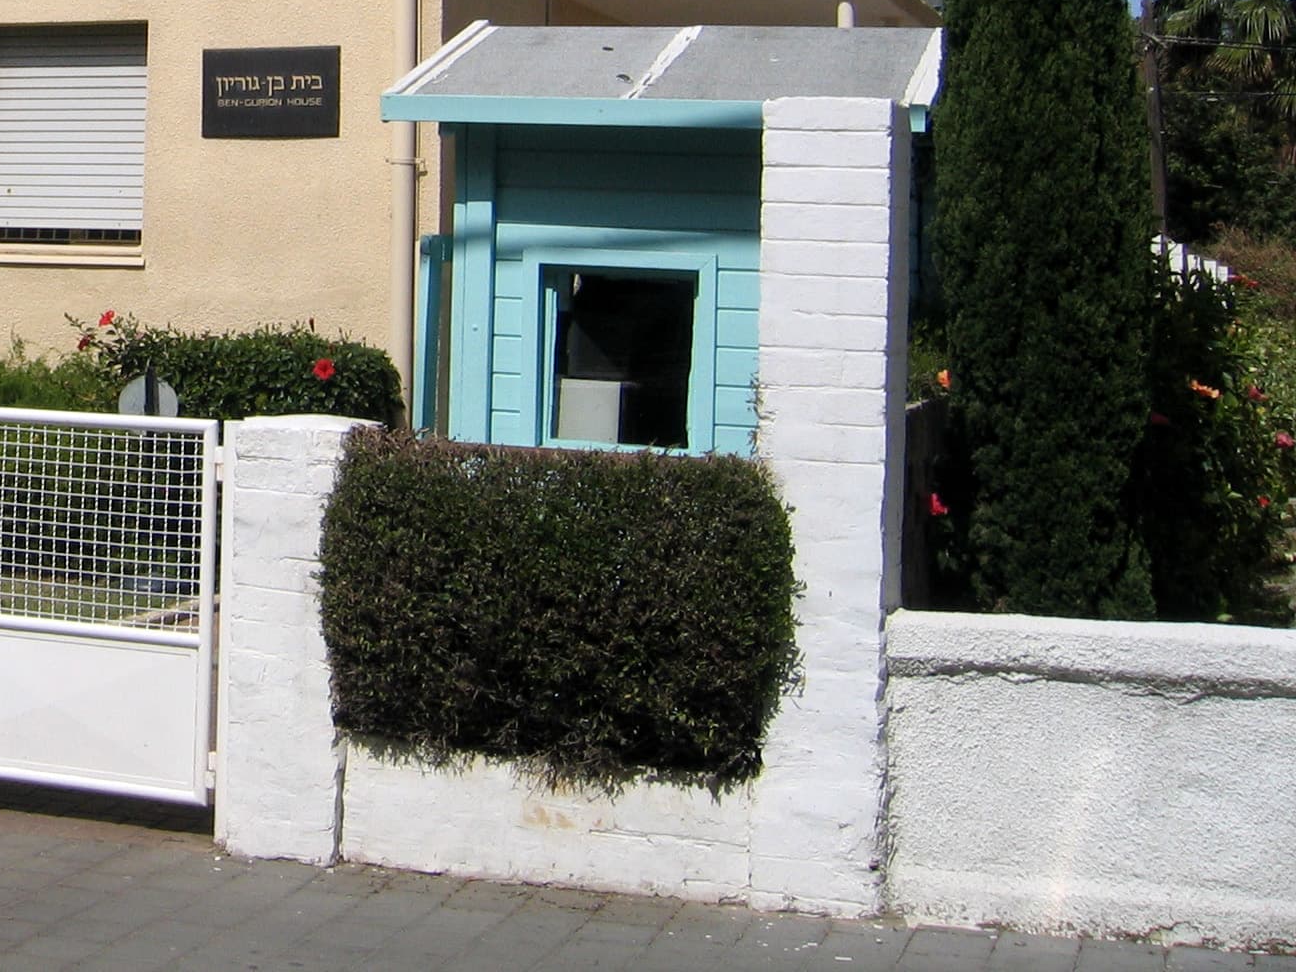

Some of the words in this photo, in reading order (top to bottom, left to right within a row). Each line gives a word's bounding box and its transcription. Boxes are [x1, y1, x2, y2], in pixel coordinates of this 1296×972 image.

[216, 76, 285, 97] בן-גוריון
[290, 75, 323, 90] בית
[217, 98, 282, 107] BEN-GURION
[287, 97, 322, 106] HOUSE
